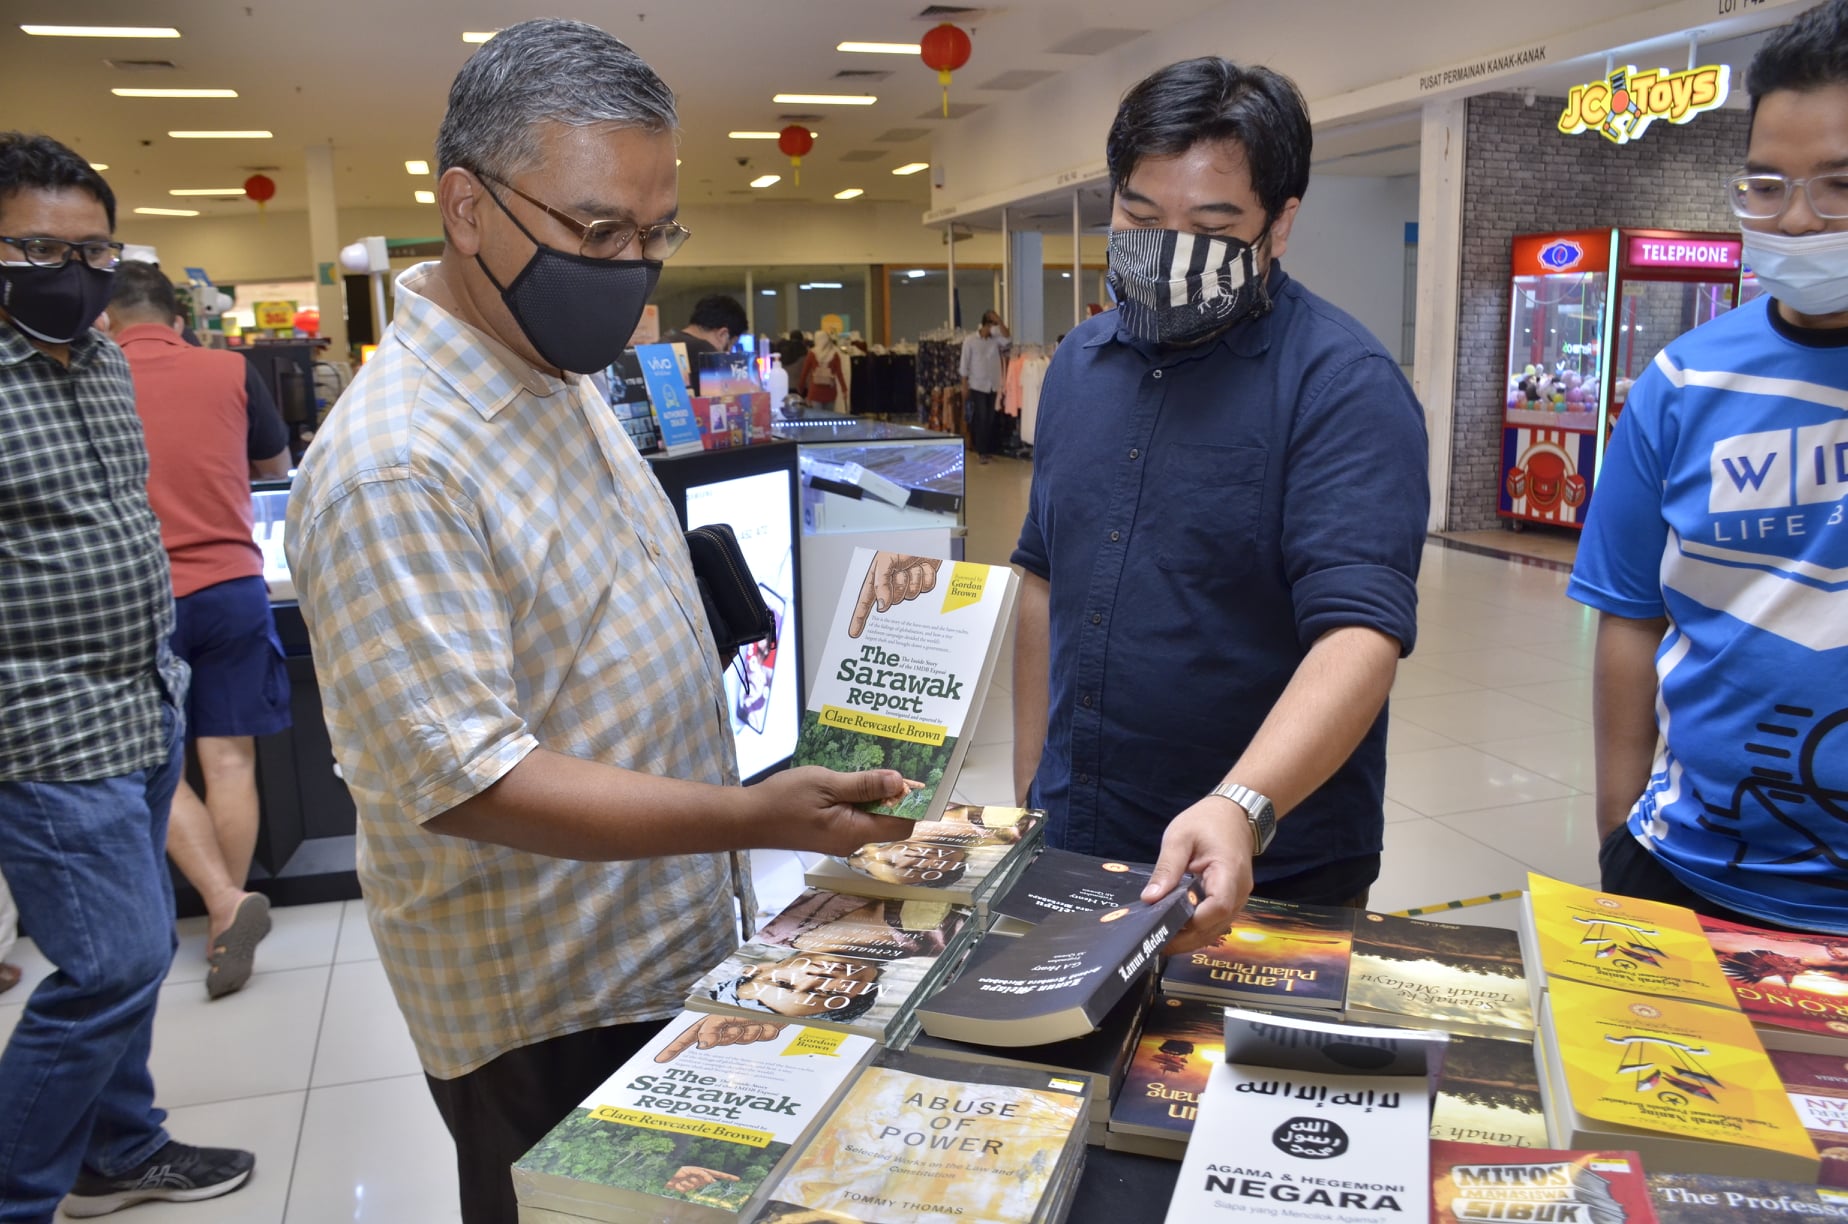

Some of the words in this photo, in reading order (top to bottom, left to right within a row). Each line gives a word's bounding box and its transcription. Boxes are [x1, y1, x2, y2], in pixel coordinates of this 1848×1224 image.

[1420, 73, 1442, 91] PUSAT
[1443, 61, 1486, 85] PERMAINAN
[1487, 46, 1546, 73] KANAK-KANAK
[1560, 85, 1608, 130] JC
[1630, 69, 1718, 120] Toys
[1642, 244, 1728, 263] TELEPHONE
[647, 357, 673, 370] vivo
[1714, 515, 1806, 541] LIFE
[951, 580, 982, 590] Gordon
[951, 587, 977, 598] Brown
[860, 645, 900, 667] The
[837, 658, 963, 700] Sarawak
[847, 687, 923, 713] Report
[824, 709, 854, 726] Clare
[854, 714, 905, 736] Rewcastle
[906, 725, 941, 741] Brown
[888, 844, 956, 858] AKU
[1035, 901, 1075, 913] elayu
[1118, 950, 1145, 982] Lanun
[1143, 925, 1169, 959] Melayu
[1191, 953, 1256, 975] Pinang
[787, 957, 867, 977] AKU
[1264, 966, 1316, 981] Pulau
[1596, 969, 1635, 982] Naning
[742, 964, 893, 998] MELAYU
[980, 984, 1037, 995] Melayu
[1037, 977, 1084, 991] Lanun
[1209, 969, 1294, 991] Lanun
[1359, 973, 1440, 994] Melayu
[1638, 977, 1680, 988] Sejarah
[743, 982, 850, 1010] OTAK
[1419, 992, 1497, 1009] Sejenak
[1448, 987, 1514, 1003] Tanah
[796, 1041, 830, 1051] Brown
[798, 1036, 837, 1047] Gordon
[662, 1068, 717, 1086] The
[627, 1075, 801, 1116] Sarawak
[1145, 1082, 1200, 1103] nang
[633, 1094, 742, 1119] Report
[904, 1092, 1020, 1117] ABUSE
[1639, 1107, 1687, 1123] Naning
[600, 1108, 638, 1122] Clare
[639, 1115, 711, 1134] Rewcastle
[713, 1127, 765, 1143] Brown
[930, 1116, 976, 1132] OF
[1690, 1116, 1743, 1131] Sejarah
[879, 1126, 1005, 1155] POWER
[1450, 1127, 1530, 1148] Tanah
[844, 1144, 892, 1162] Selected
[894, 1156, 927, 1168] Works
[928, 1161, 942, 1169] on
[943, 1160, 963, 1171] the
[965, 1163, 987, 1174] Law
[989, 1165, 1015, 1177] and
[889, 1165, 956, 1180] Constitution
[1206, 1163, 1273, 1179] AGAMA
[1280, 1173, 1293, 1182] &
[1300, 1175, 1405, 1193] HEGEMONI
[1458, 1165, 1568, 1186] MITOS
[842, 1190, 896, 1208] TOMMY
[902, 1201, 964, 1215] THOMAS
[1204, 1174, 1403, 1212] NEGARA
[1466, 1189, 1569, 1199] MAHASISWA
[1657, 1187, 1719, 1205] The
[1213, 1199, 1246, 1212] Siapa
[1249, 1206, 1278, 1217] yang
[1335, 1214, 1386, 1224] Agama?
[1463, 1201, 1581, 1222] SIBUK
